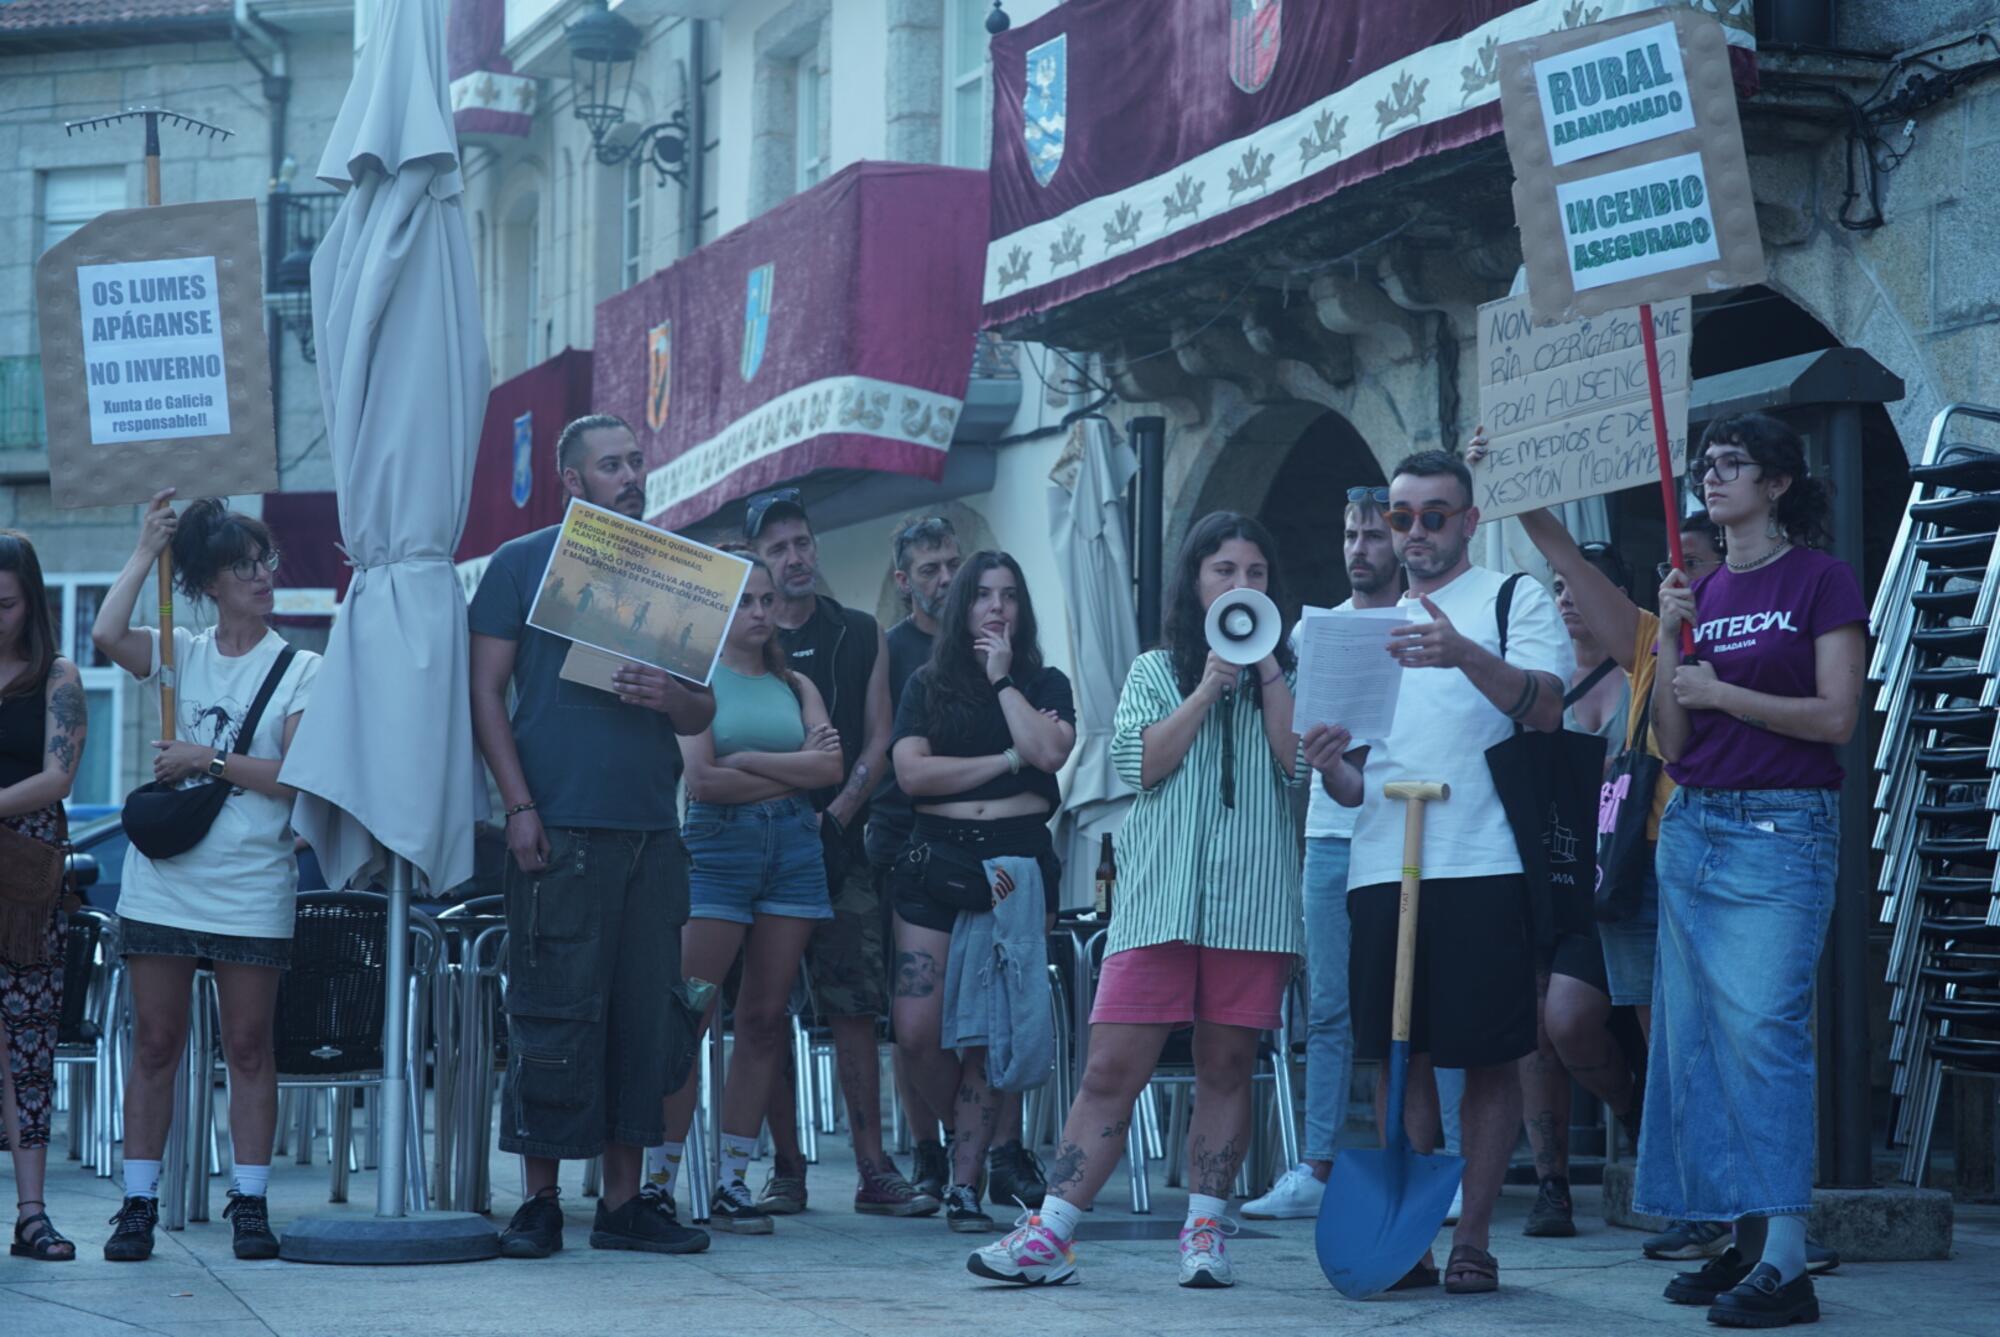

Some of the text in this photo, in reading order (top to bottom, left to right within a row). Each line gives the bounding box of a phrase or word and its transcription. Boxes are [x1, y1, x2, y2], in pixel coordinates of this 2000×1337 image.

[1547, 43, 1673, 115] RURAL
[1553, 90, 1683, 146] ABANDONADO
[1565, 174, 1704, 234] INCENDIO
[1573, 217, 1711, 271] ASEGURADO
[92, 275, 207, 307] OS LUMES
[92, 309, 213, 342] APÁGANSE
[1490, 308, 1533, 346] NON
[90, 354, 220, 385] NO INVERNO
[1488, 350, 1676, 431] POLA AUSENCA
[103, 392, 214, 415] Xunta de Galicia
[111, 412, 208, 434] responsable!!
[1518, 422, 1591, 464] MEDIOS
[1597, 414, 1615, 444] E
[1620, 409, 1653, 437] DE
[570, 527, 605, 544] PLANTAS
[612, 542, 645, 559] ESPAZOS
[584, 511, 595, 519] DE
[667, 540, 713, 562] QUEIMADAS
[658, 550, 668, 559] DE
[566, 539, 597, 556] MENOS
[615, 557, 623, 565] O
[625, 560, 649, 574] POBO
[650, 569, 678, 584] SALVA
[678, 579, 693, 589] AO
[589, 559, 627, 577] MEDIDAS
[627, 572, 638, 581] DE
[692, 594, 731, 613] EFICACES
